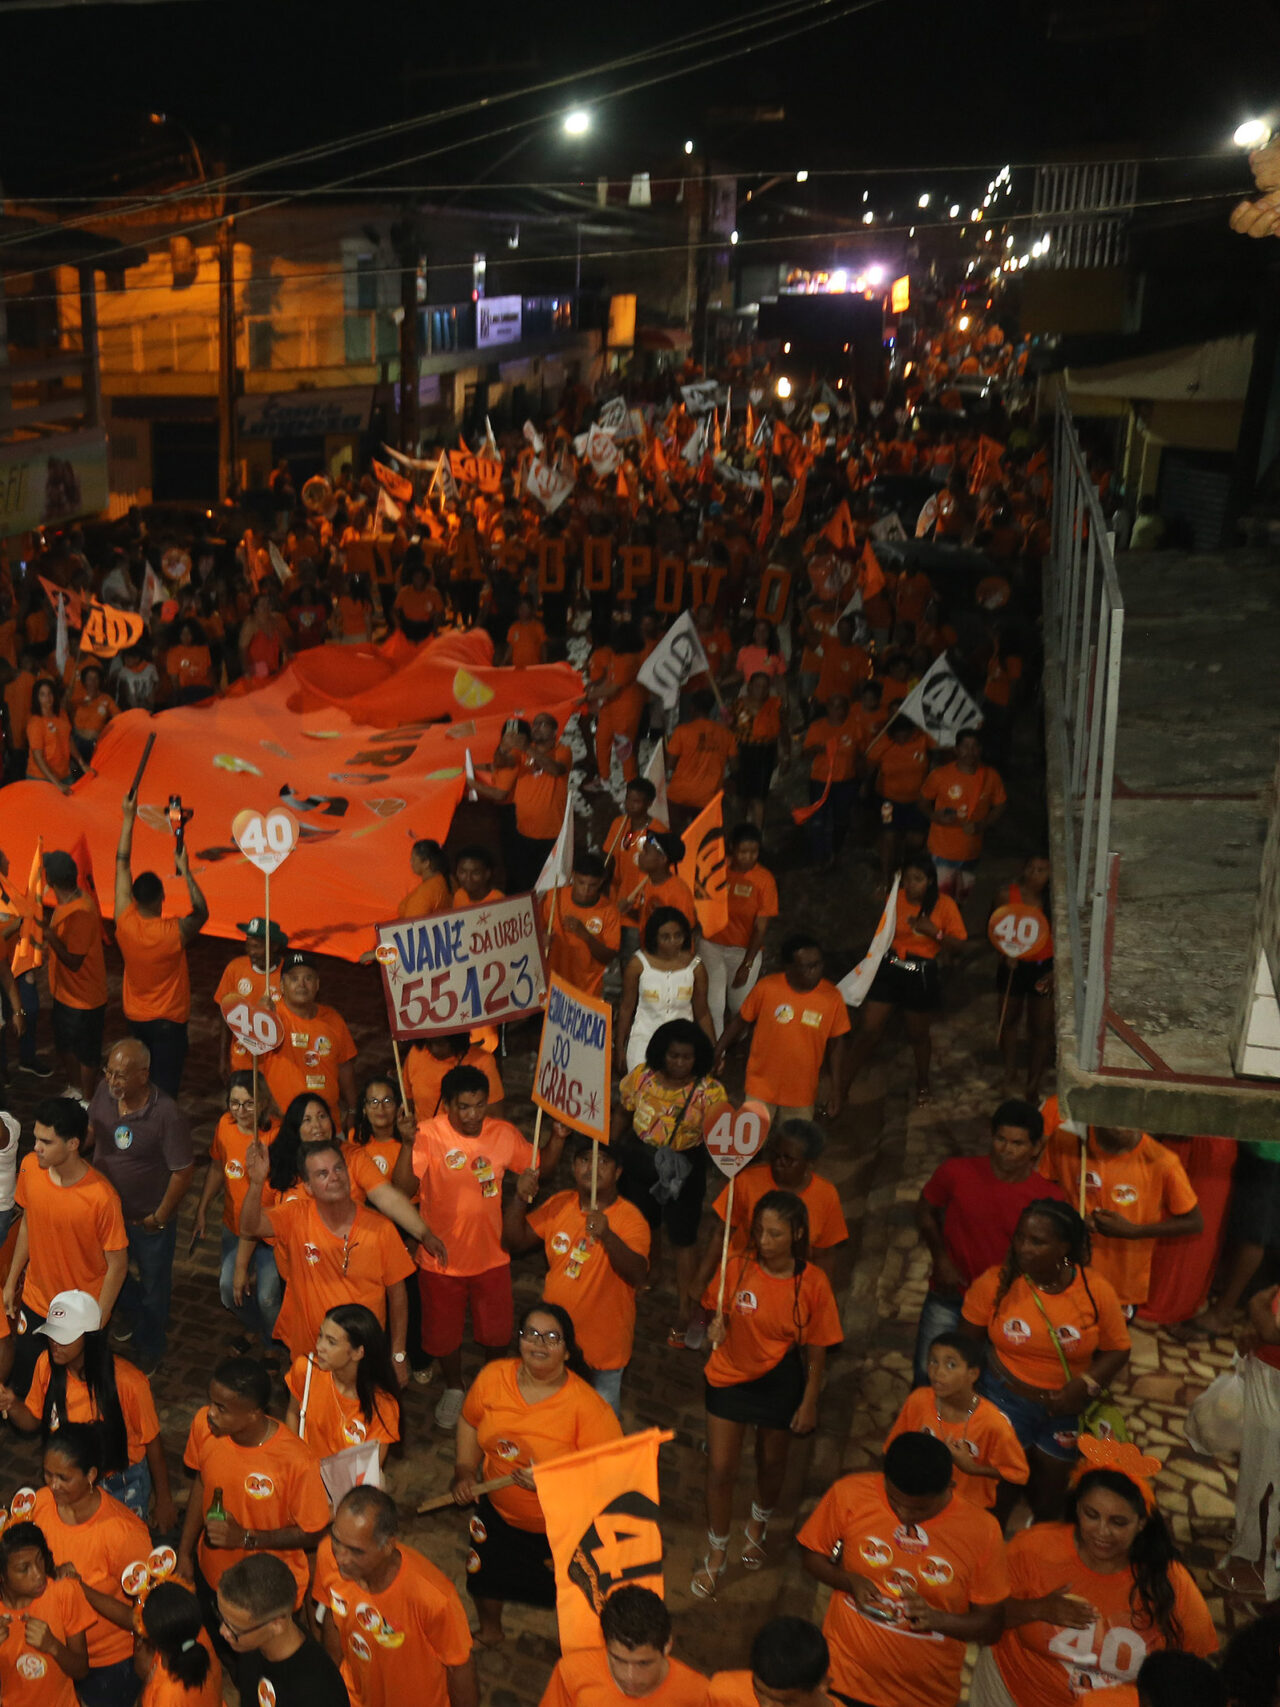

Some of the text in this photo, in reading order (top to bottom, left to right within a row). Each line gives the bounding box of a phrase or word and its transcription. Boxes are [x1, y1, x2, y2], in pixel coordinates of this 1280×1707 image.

[240, 814, 293, 855] 40
[993, 914, 1040, 945] 40
[226, 1002, 278, 1048] 40
[707, 1111, 761, 1156] 40
[1047, 1619, 1148, 1678] 40
